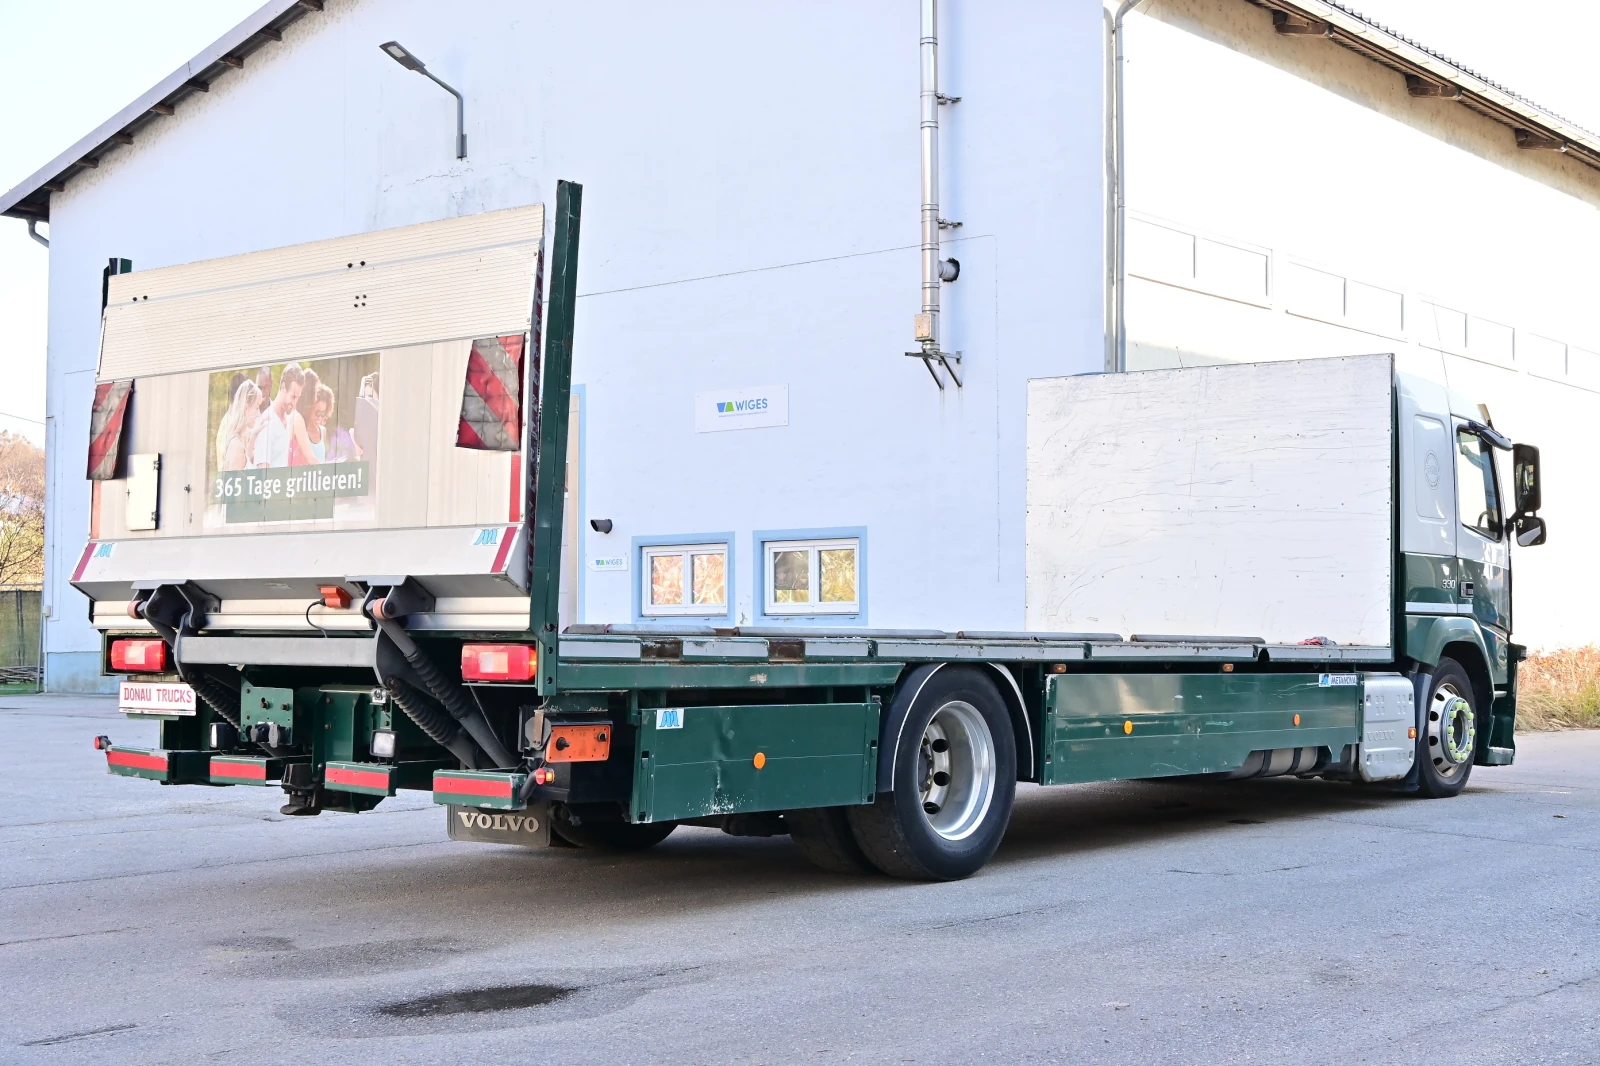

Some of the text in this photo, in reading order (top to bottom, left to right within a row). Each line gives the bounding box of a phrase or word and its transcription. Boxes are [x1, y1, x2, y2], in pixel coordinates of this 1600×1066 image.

[735, 398, 768, 411] WIGES
[214, 468, 362, 499] 365 Tage grillieren!
[605, 558, 623, 566] WIGES
[1442, 579, 1456, 589] 330
[123, 687, 193, 704] DONAU TRUCKS
[1366, 730, 1395, 741] VOLVO
[457, 811, 539, 833] VOLVO
